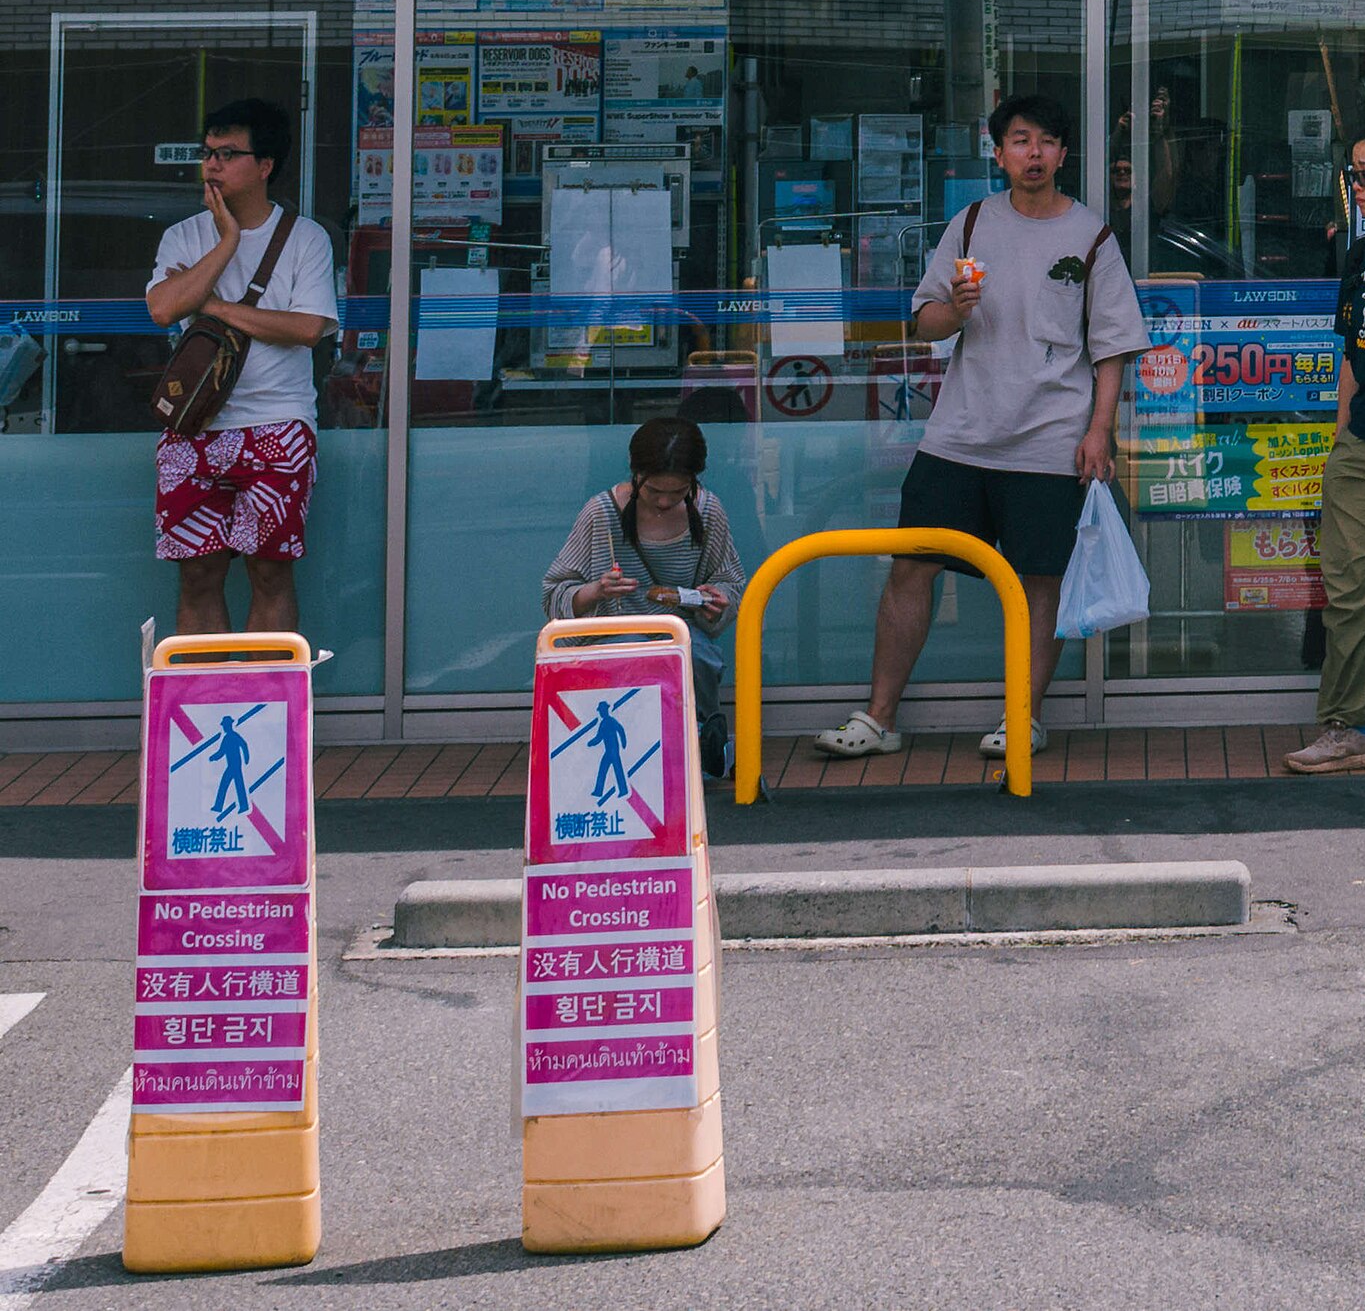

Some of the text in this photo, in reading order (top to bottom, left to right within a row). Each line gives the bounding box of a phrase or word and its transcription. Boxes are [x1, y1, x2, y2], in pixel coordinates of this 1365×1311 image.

[528, 47, 552, 61] DOGS
[627, 112, 670, 121] SuperShow
[672, 112, 703, 120] Summer
[705, 112, 721, 120] Tour
[1234, 291, 1297, 303] LAWSON
[12, 309, 81, 322] LAWSON
[1151, 319, 1212, 331] LAWSON
[1191, 343, 1293, 386] 250円
[1295, 352, 1335, 373] 毎月
[1202, 387, 1284, 404] 割引クーポン
[1165, 450, 1224, 480] バイク
[1150, 476, 1242, 506] 自賠責保険
[555, 811, 625, 840] 横断禁止
[172, 825, 244, 855] 横断禁止
[542, 876, 676, 900] No Pedestrian
[154, 900, 294, 920] No Pedestrian
[569, 906, 650, 927] Crossing
[181, 929, 265, 951] Crossing
[533, 943, 686, 978] 没有人行横道
[142, 969, 300, 998] 没有人行横道
[555, 991, 661, 1023] 횡단 금지
[162, 1015, 273, 1045] 횡단 금지
[528, 1041, 691, 1072] ห้ามคนเดินเท้าข้าม
[134, 1067, 300, 1092] ห้ามคนเดินเท้าข้าม
